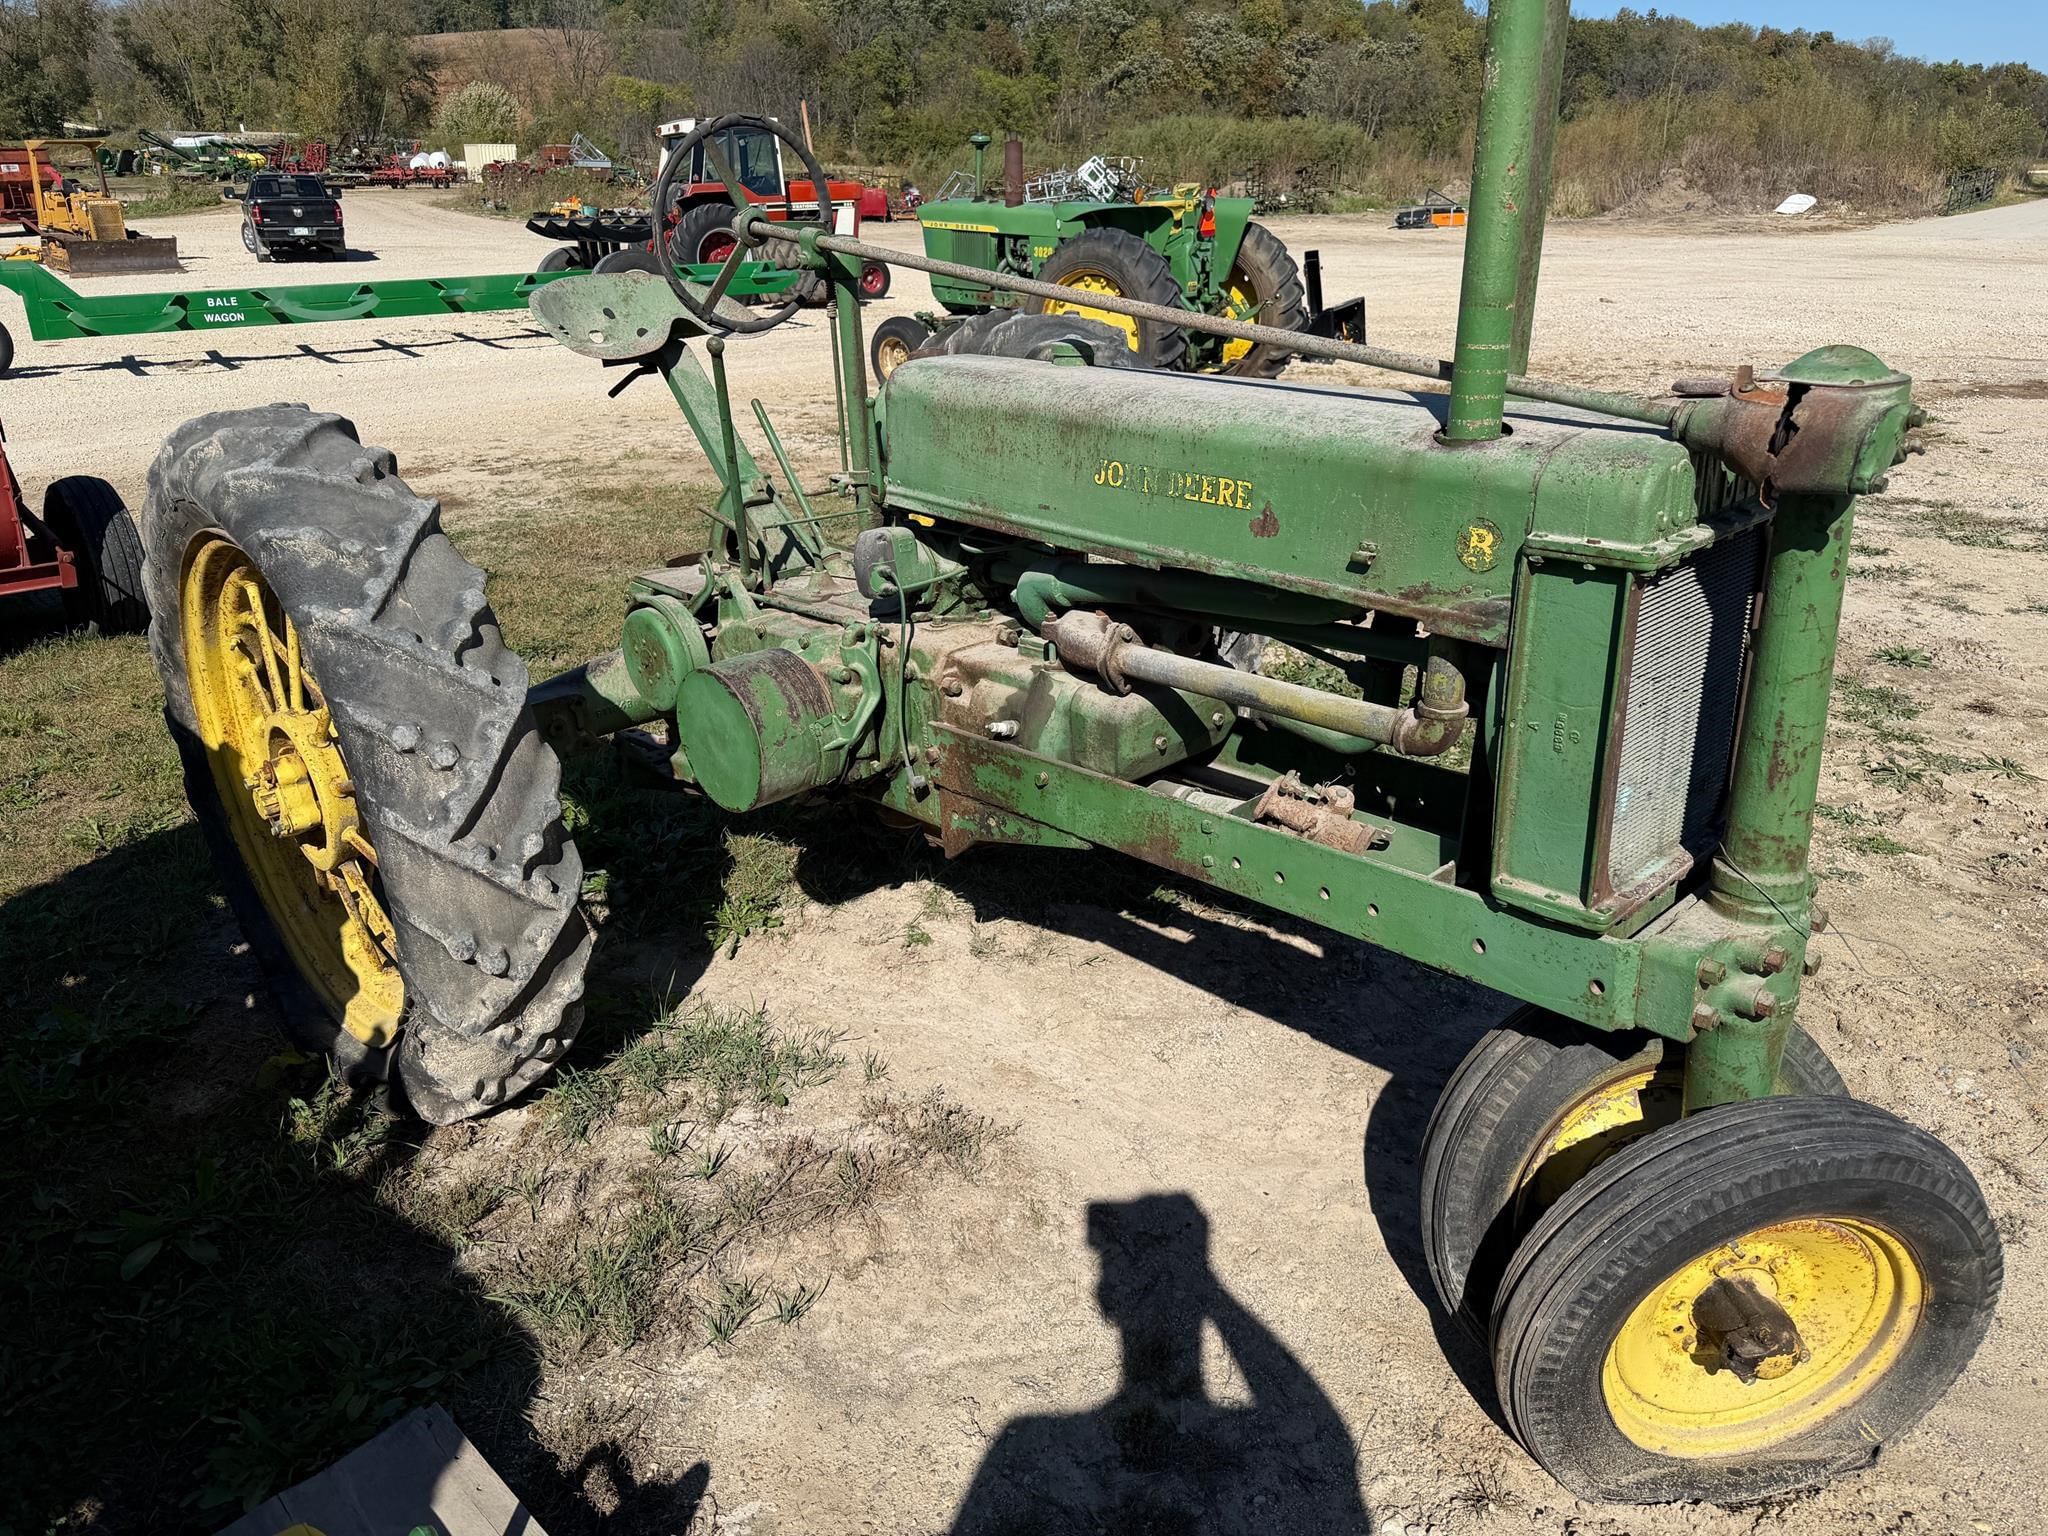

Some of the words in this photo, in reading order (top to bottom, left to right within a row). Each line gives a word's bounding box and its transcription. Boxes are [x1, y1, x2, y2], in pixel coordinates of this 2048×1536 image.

[206, 296, 239, 308] BALE
[204, 312, 245, 323] WAGON
[1167, 471, 1253, 511] DEERE
